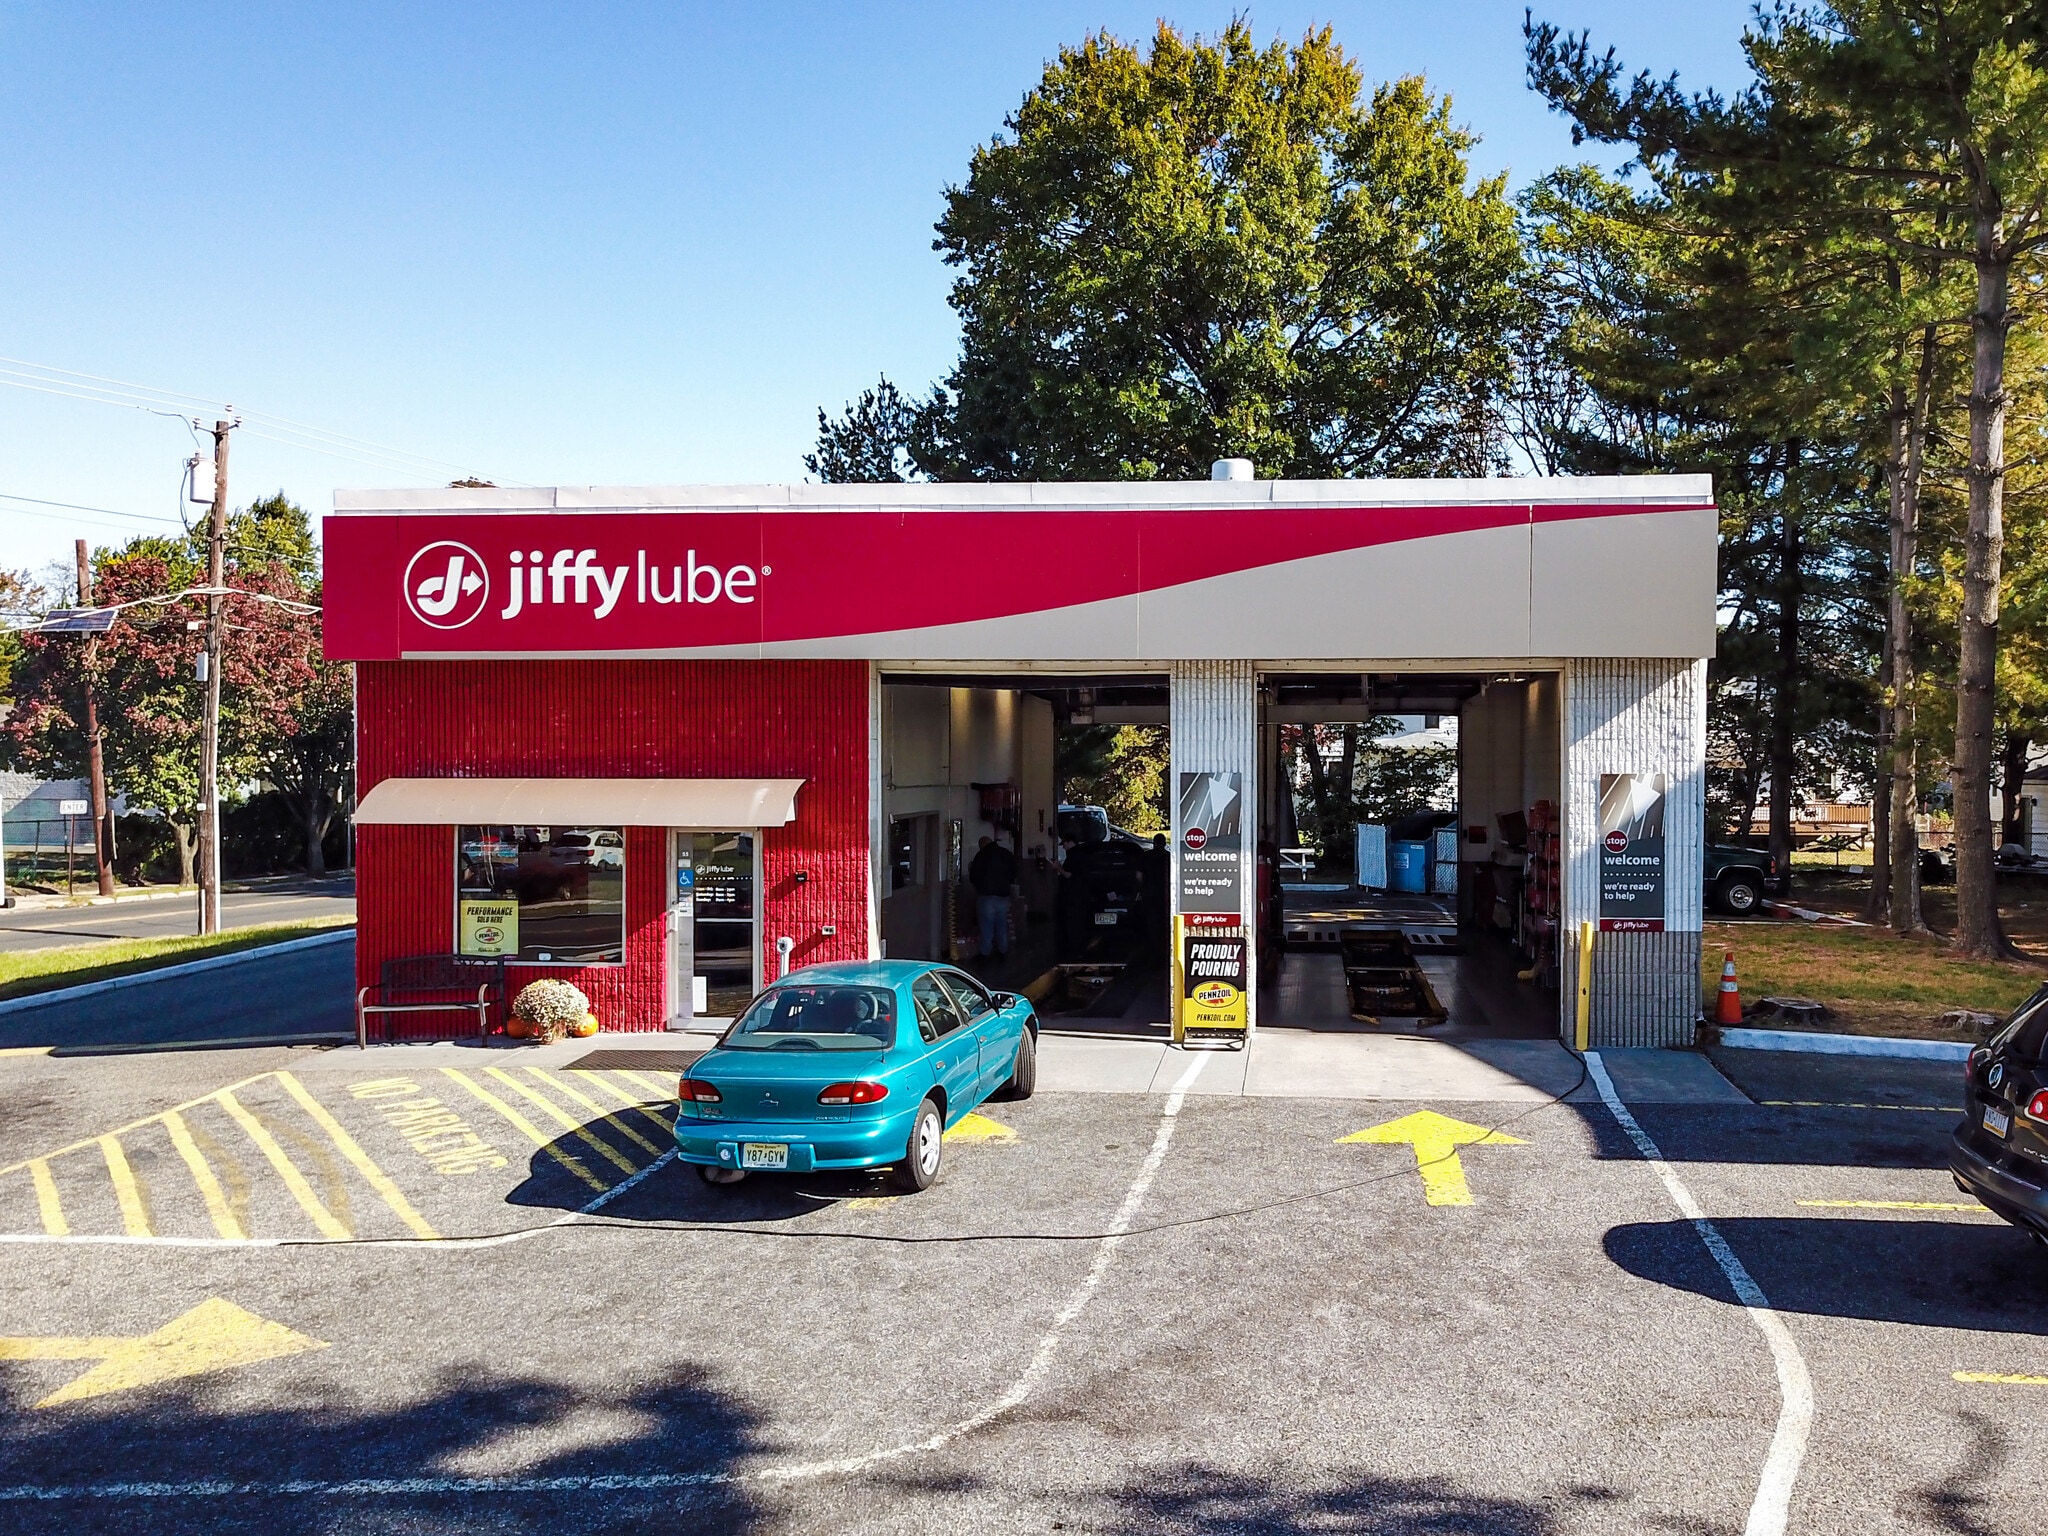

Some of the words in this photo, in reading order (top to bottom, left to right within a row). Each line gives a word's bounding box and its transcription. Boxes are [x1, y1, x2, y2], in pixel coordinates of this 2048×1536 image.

[501, 549, 630, 620] jiffy
[1186, 833, 1205, 843] stop
[1606, 837, 1626, 846] stop
[1184, 851, 1238, 862] welcome
[1604, 854, 1660, 865] welcome
[1184, 878, 1207, 887] we're
[1208, 877, 1233, 888] ready
[1604, 882, 1628, 890] we're
[1629, 882, 1655, 892] ready
[1184, 887, 1194, 896] to
[1194, 886, 1215, 897] help
[1615, 891, 1636, 901] help
[466, 906, 514, 916] PERFORMANCE
[476, 916, 490, 924] SOLD
[490, 916, 504, 924] HERE
[1190, 944, 1242, 960] PROUDLY
[1190, 961, 1241, 977] POURING
[1198, 988, 1232, 1000] PENNZOIL
[1196, 1013, 1237, 1022] PENNZOIL.COM
[346, 1076, 422, 1100] NO
[374, 1097, 509, 1175] PARKING
